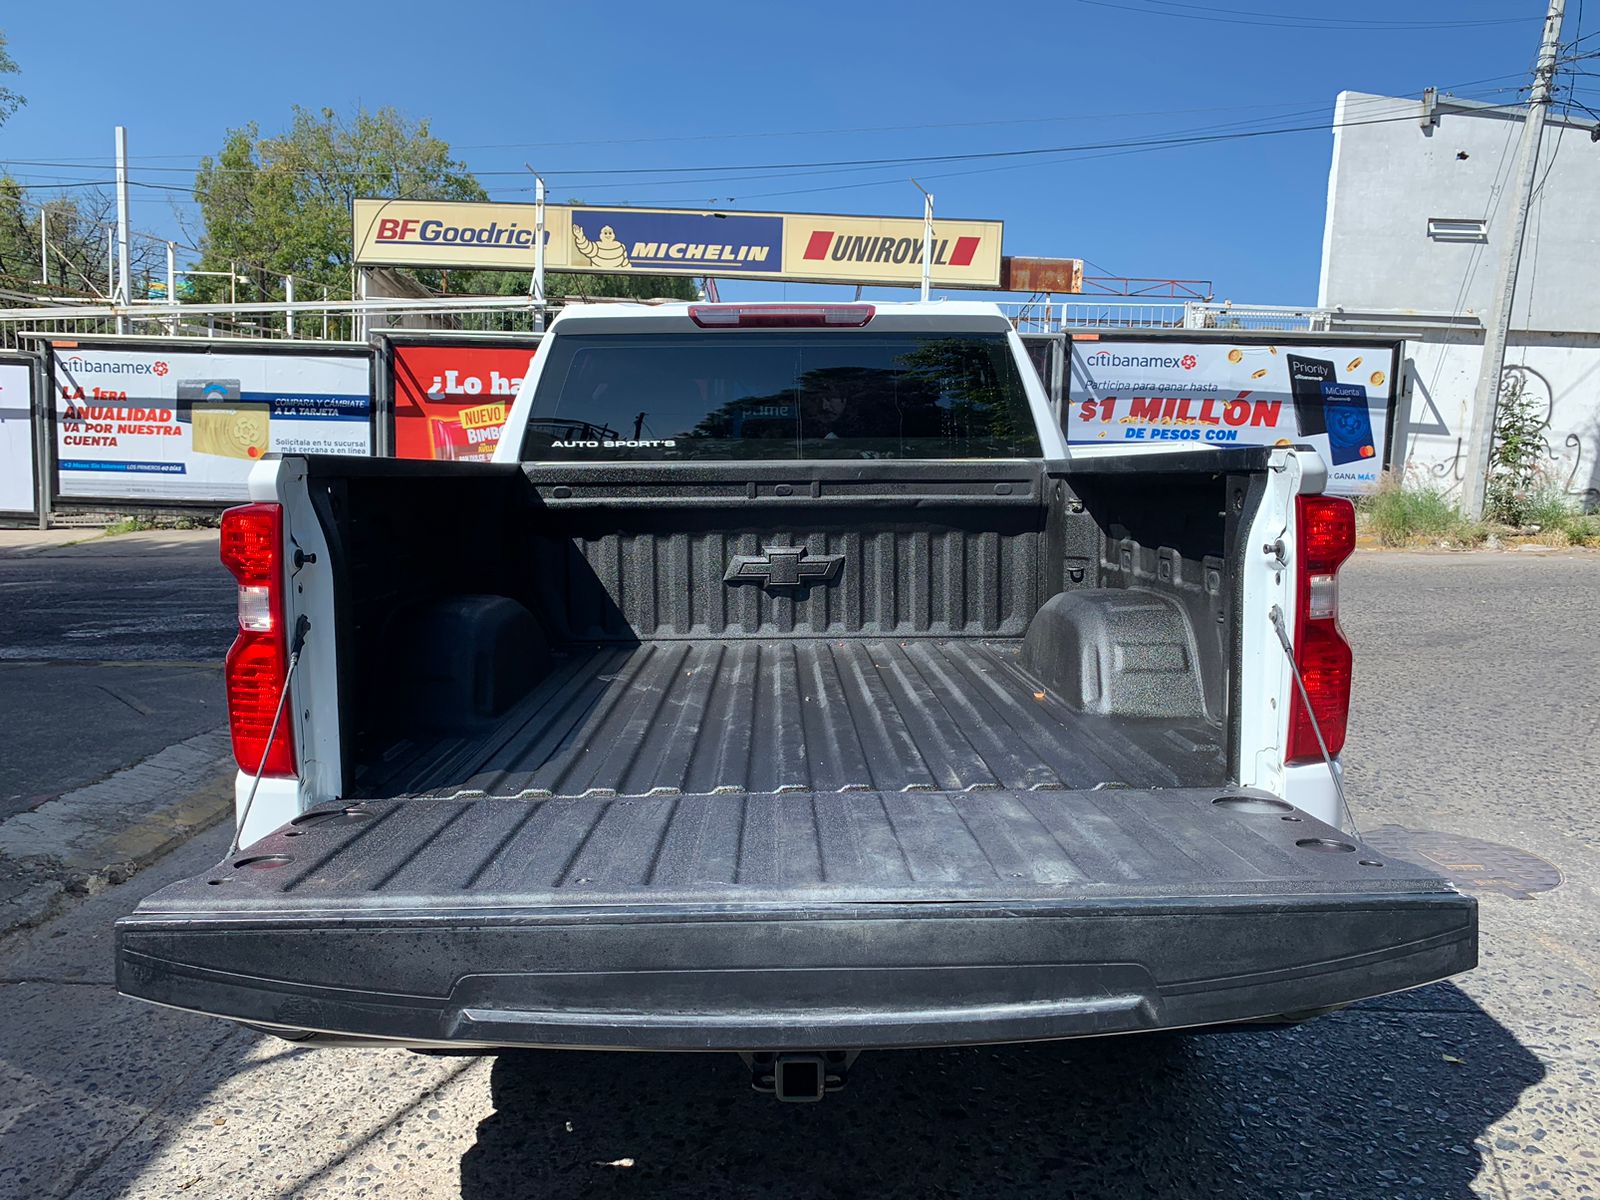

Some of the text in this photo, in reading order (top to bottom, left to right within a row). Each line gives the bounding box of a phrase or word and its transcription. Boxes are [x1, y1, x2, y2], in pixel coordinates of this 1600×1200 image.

[631, 242, 770, 262] MICHELIN
[60, 357, 152, 375] citibanamex
[1087, 351, 1180, 369] citibanamex
[1293, 361, 1328, 376] Priority
[427, 370, 483, 400] ¿Lo
[1084, 380, 1219, 393] Participa para ganar hasta
[1325, 387, 1360, 397] MiCuenta
[62, 386, 128, 402] LA 1ERA
[275, 398, 366, 409] COMPARA Y CÁMBIATE
[1078, 391, 1282, 428] $1 MILLÓN
[62, 406, 173, 422] ANUALIDAD
[274, 407, 339, 417] A LA TARJETA
[464, 406, 501, 426] NUEVO
[63, 422, 182, 436] VA POR NUESTRA
[1125, 427, 1238, 441] DE PESOS CON
[63, 435, 118, 447] CUENTA
[334, 440, 366, 448] sucursal
[551, 440, 676, 448] AUTO SPORT'S
[298, 447, 329, 455] cercana
[1333, 472, 1356, 480] GANA
